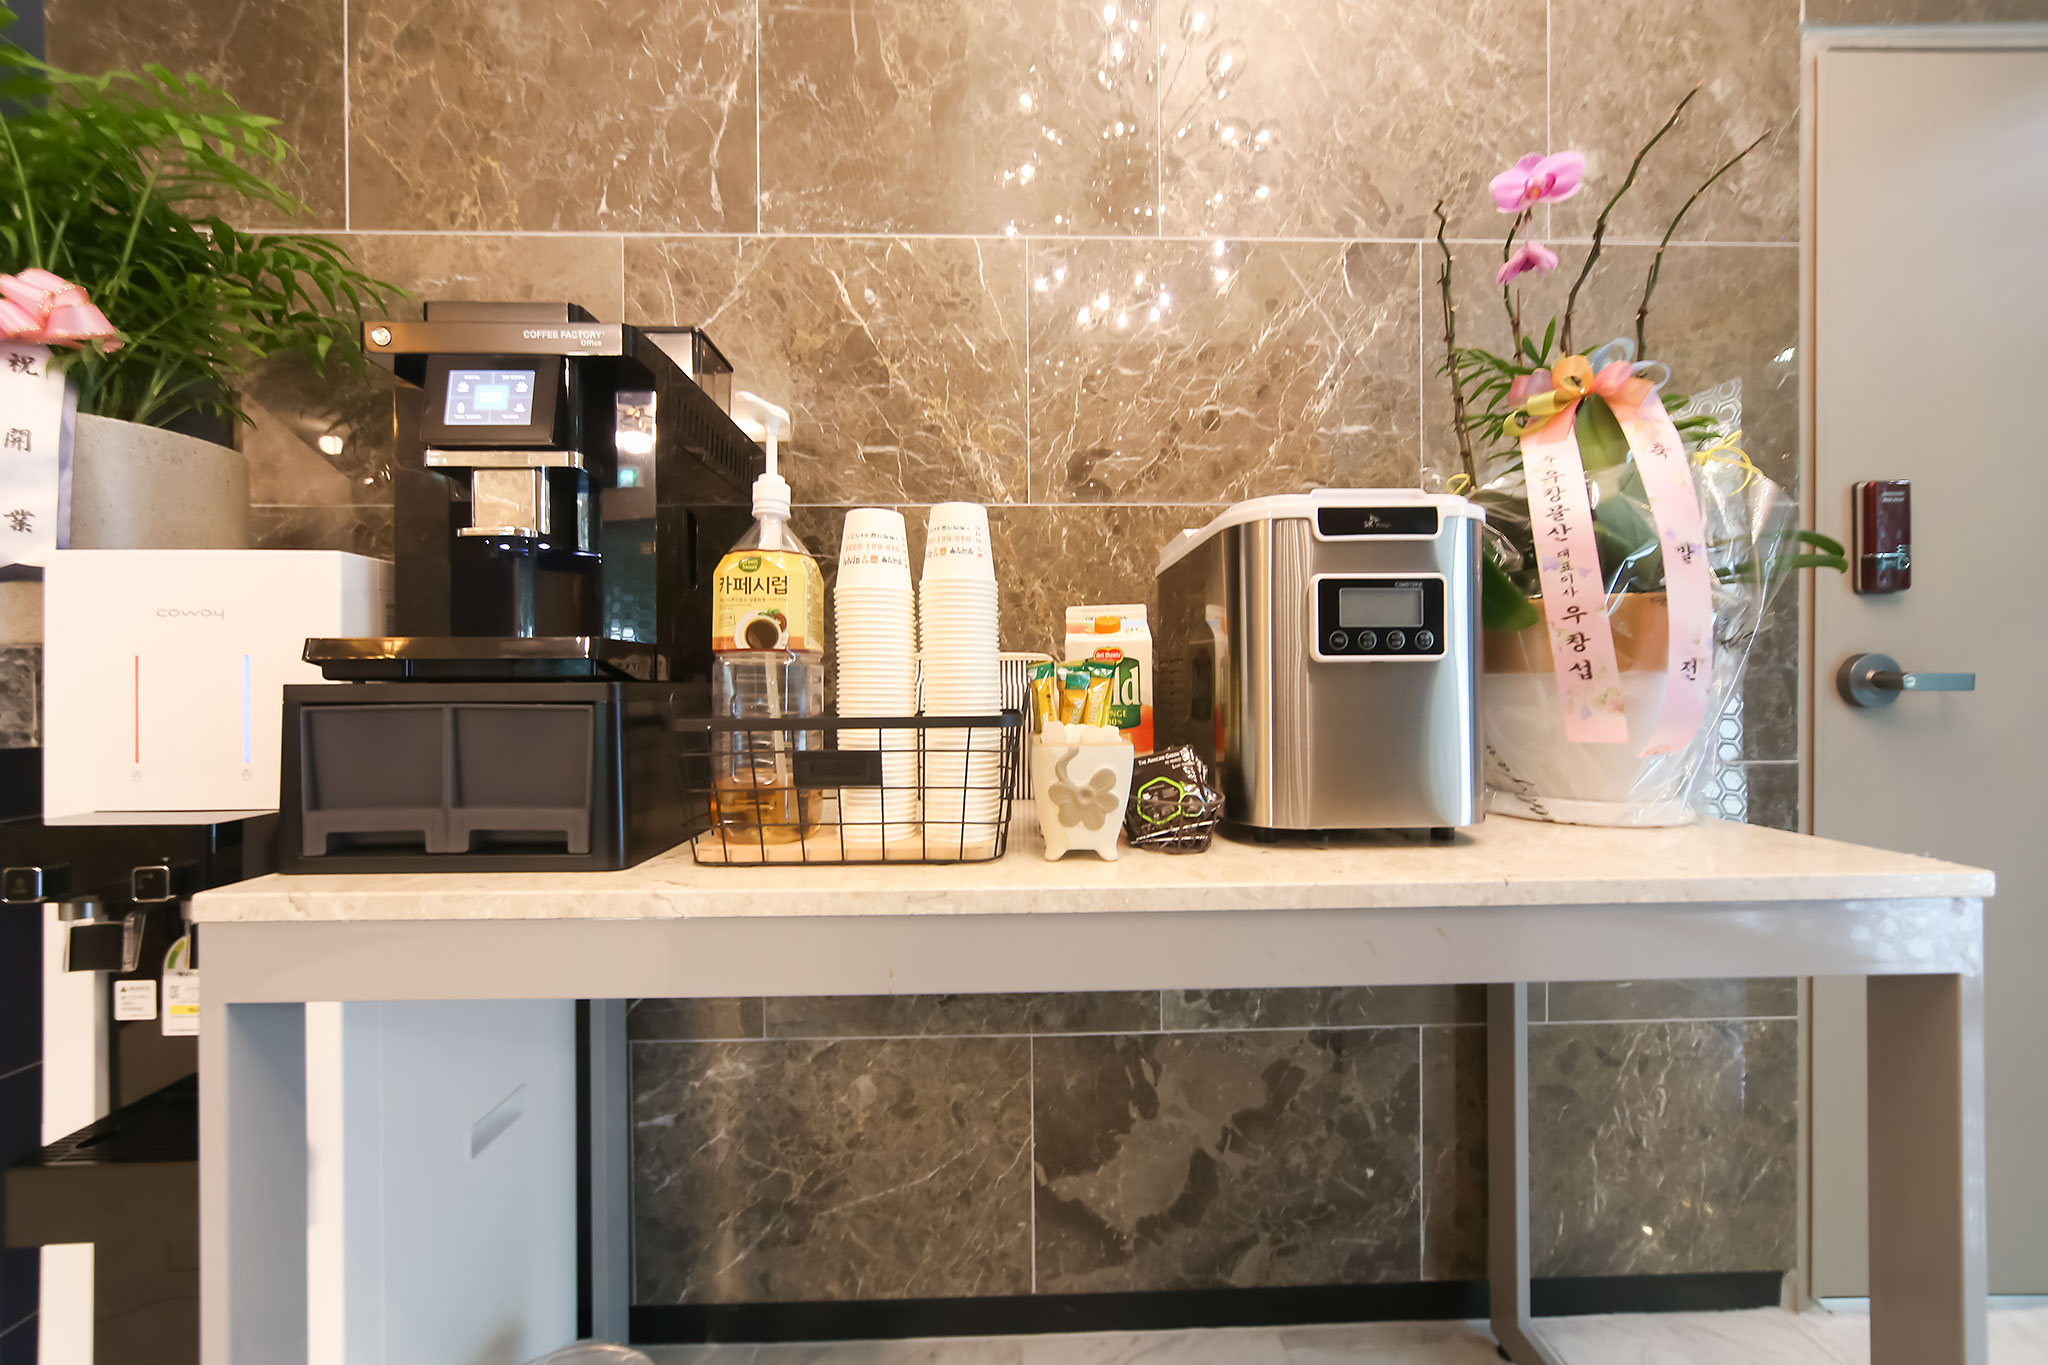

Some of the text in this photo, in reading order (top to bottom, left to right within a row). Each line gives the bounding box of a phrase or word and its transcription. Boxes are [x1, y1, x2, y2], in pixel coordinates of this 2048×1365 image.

[523, 330, 601, 339] COFFEE FACTORY
[1557, 547, 1578, 598] 대표이사
[719, 576, 788, 595] 카페시럽
[156, 608, 225, 621] coway
[1561, 605, 1593, 680] 우창섭
